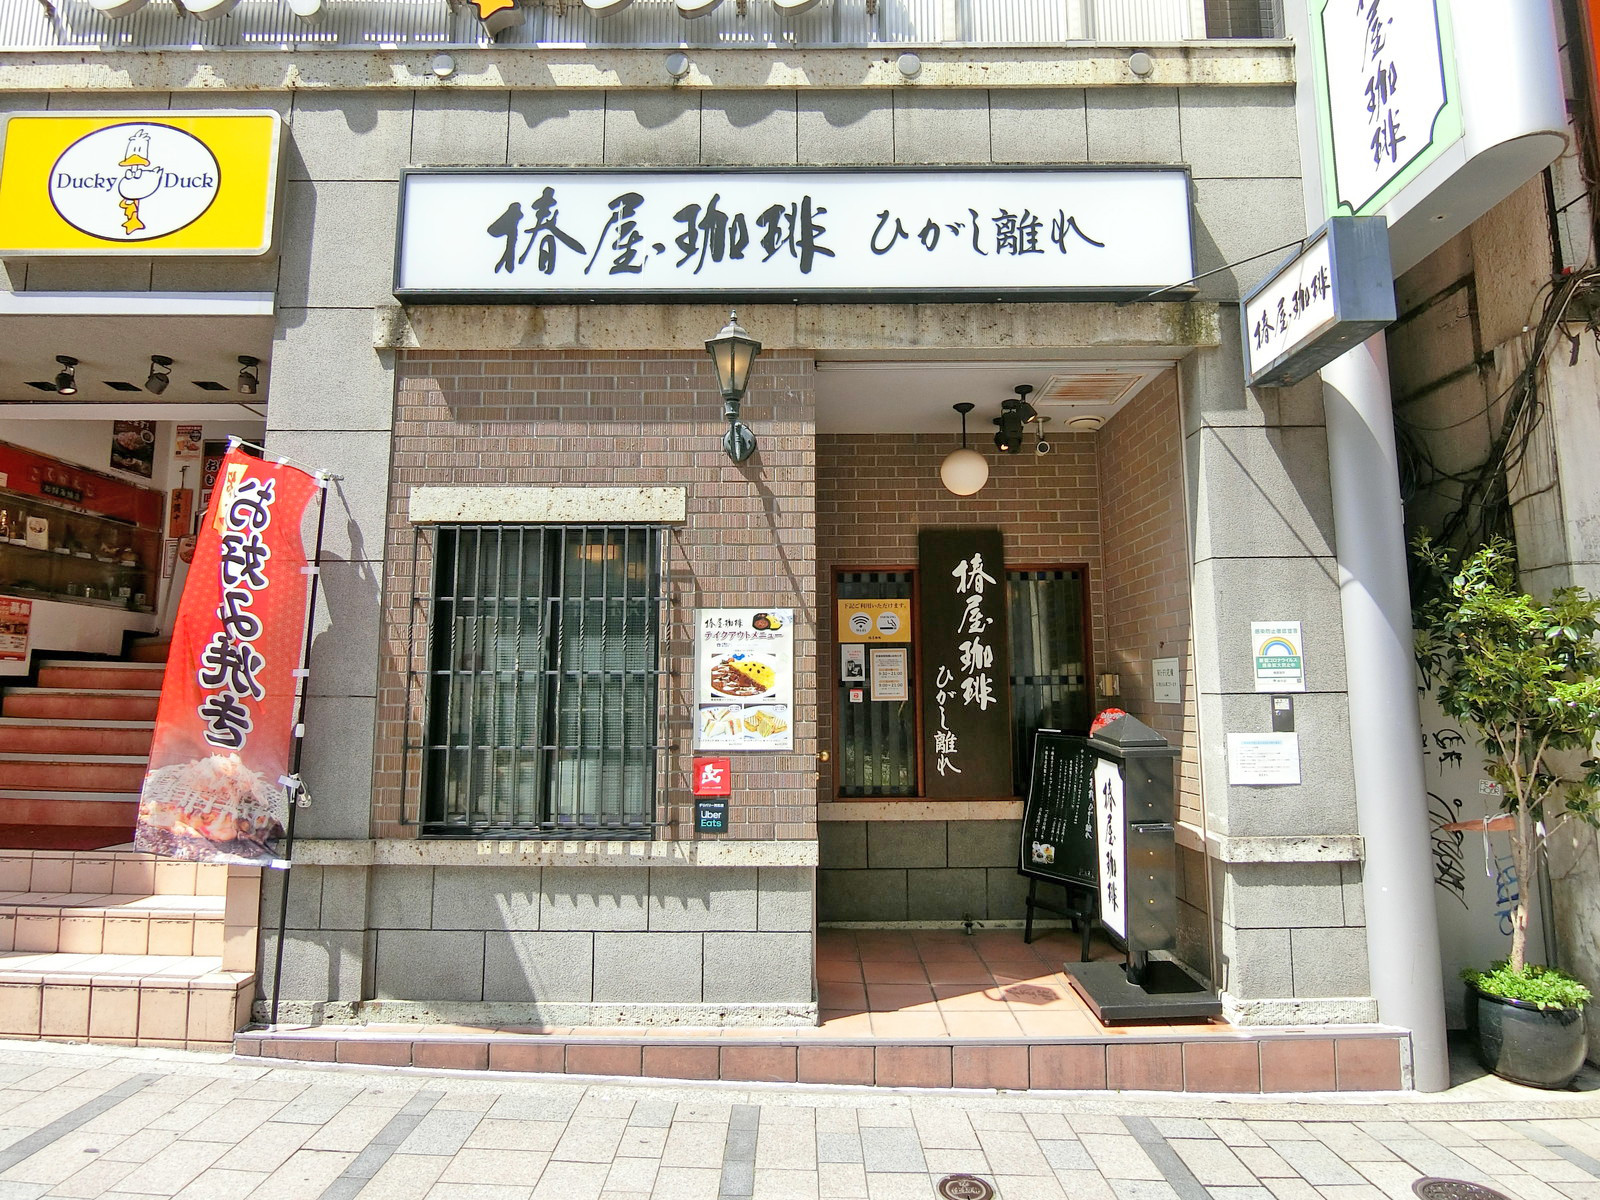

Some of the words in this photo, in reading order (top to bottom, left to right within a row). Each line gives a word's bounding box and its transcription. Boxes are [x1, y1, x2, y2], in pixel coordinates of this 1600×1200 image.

[1356, 0, 1407, 172] 屋珈琲
[57, 172, 118, 192] Ducky
[164, 172, 214, 189] Duck
[487, 186, 836, 275] 椿屋珈琲
[870, 207, 1106, 256] ひがし離れ
[1253, 265, 1332, 351] 椿屋珈琲
[704, 630, 784, 641] テイクアウトメニュー
[952, 552, 997, 711] 椿屋珈琲
[933, 665, 962, 777] ひがし離れ
[700, 810, 722, 819] Uber
[700, 819, 722, 827] Eats
